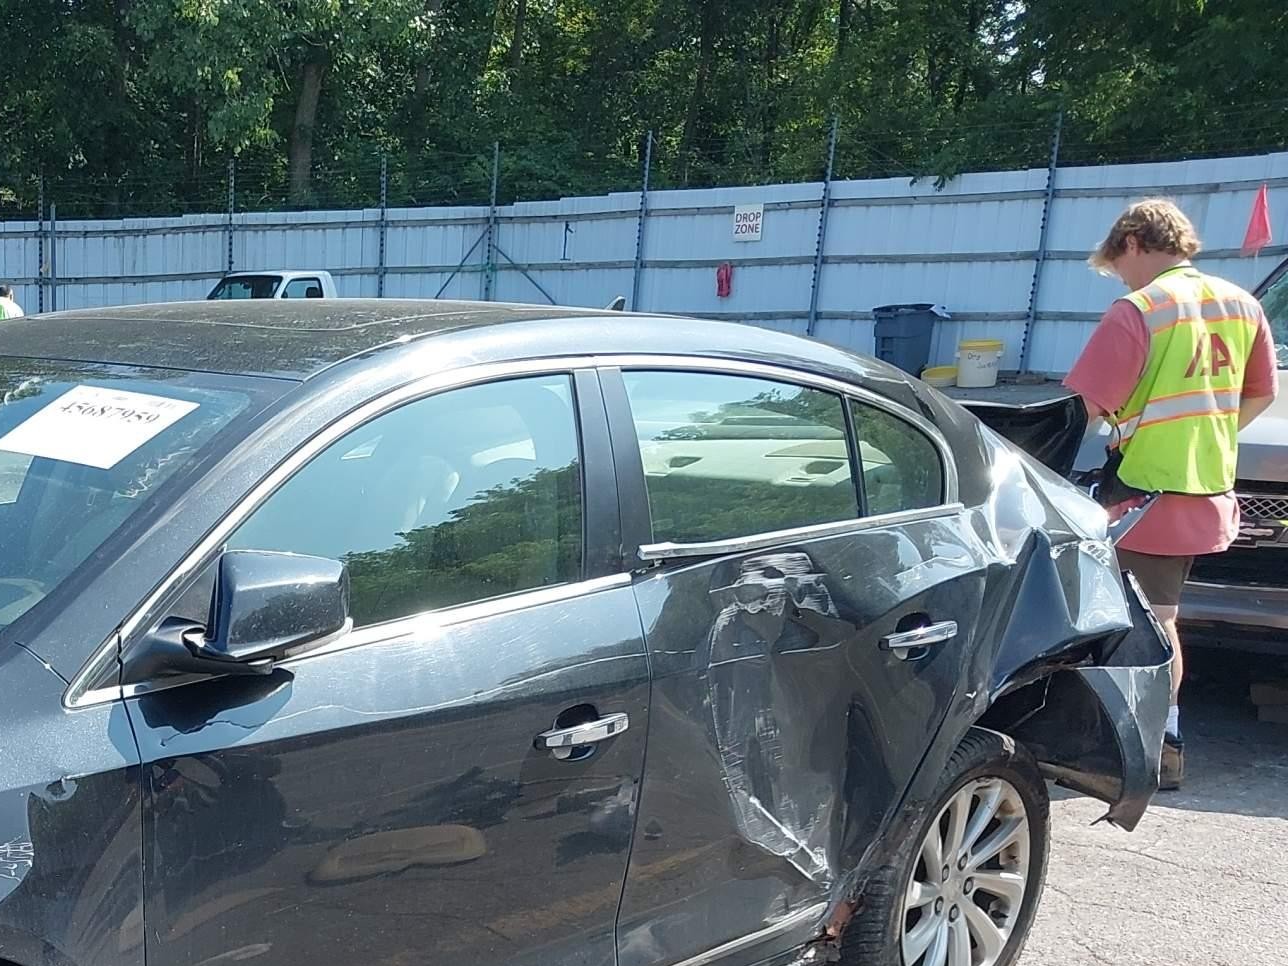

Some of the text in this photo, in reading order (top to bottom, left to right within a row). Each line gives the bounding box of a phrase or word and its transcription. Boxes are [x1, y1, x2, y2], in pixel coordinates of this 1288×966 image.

[735, 212, 762, 223] DROP
[735, 223, 761, 234] ZONE
[60, 401, 161, 425] 45687959
